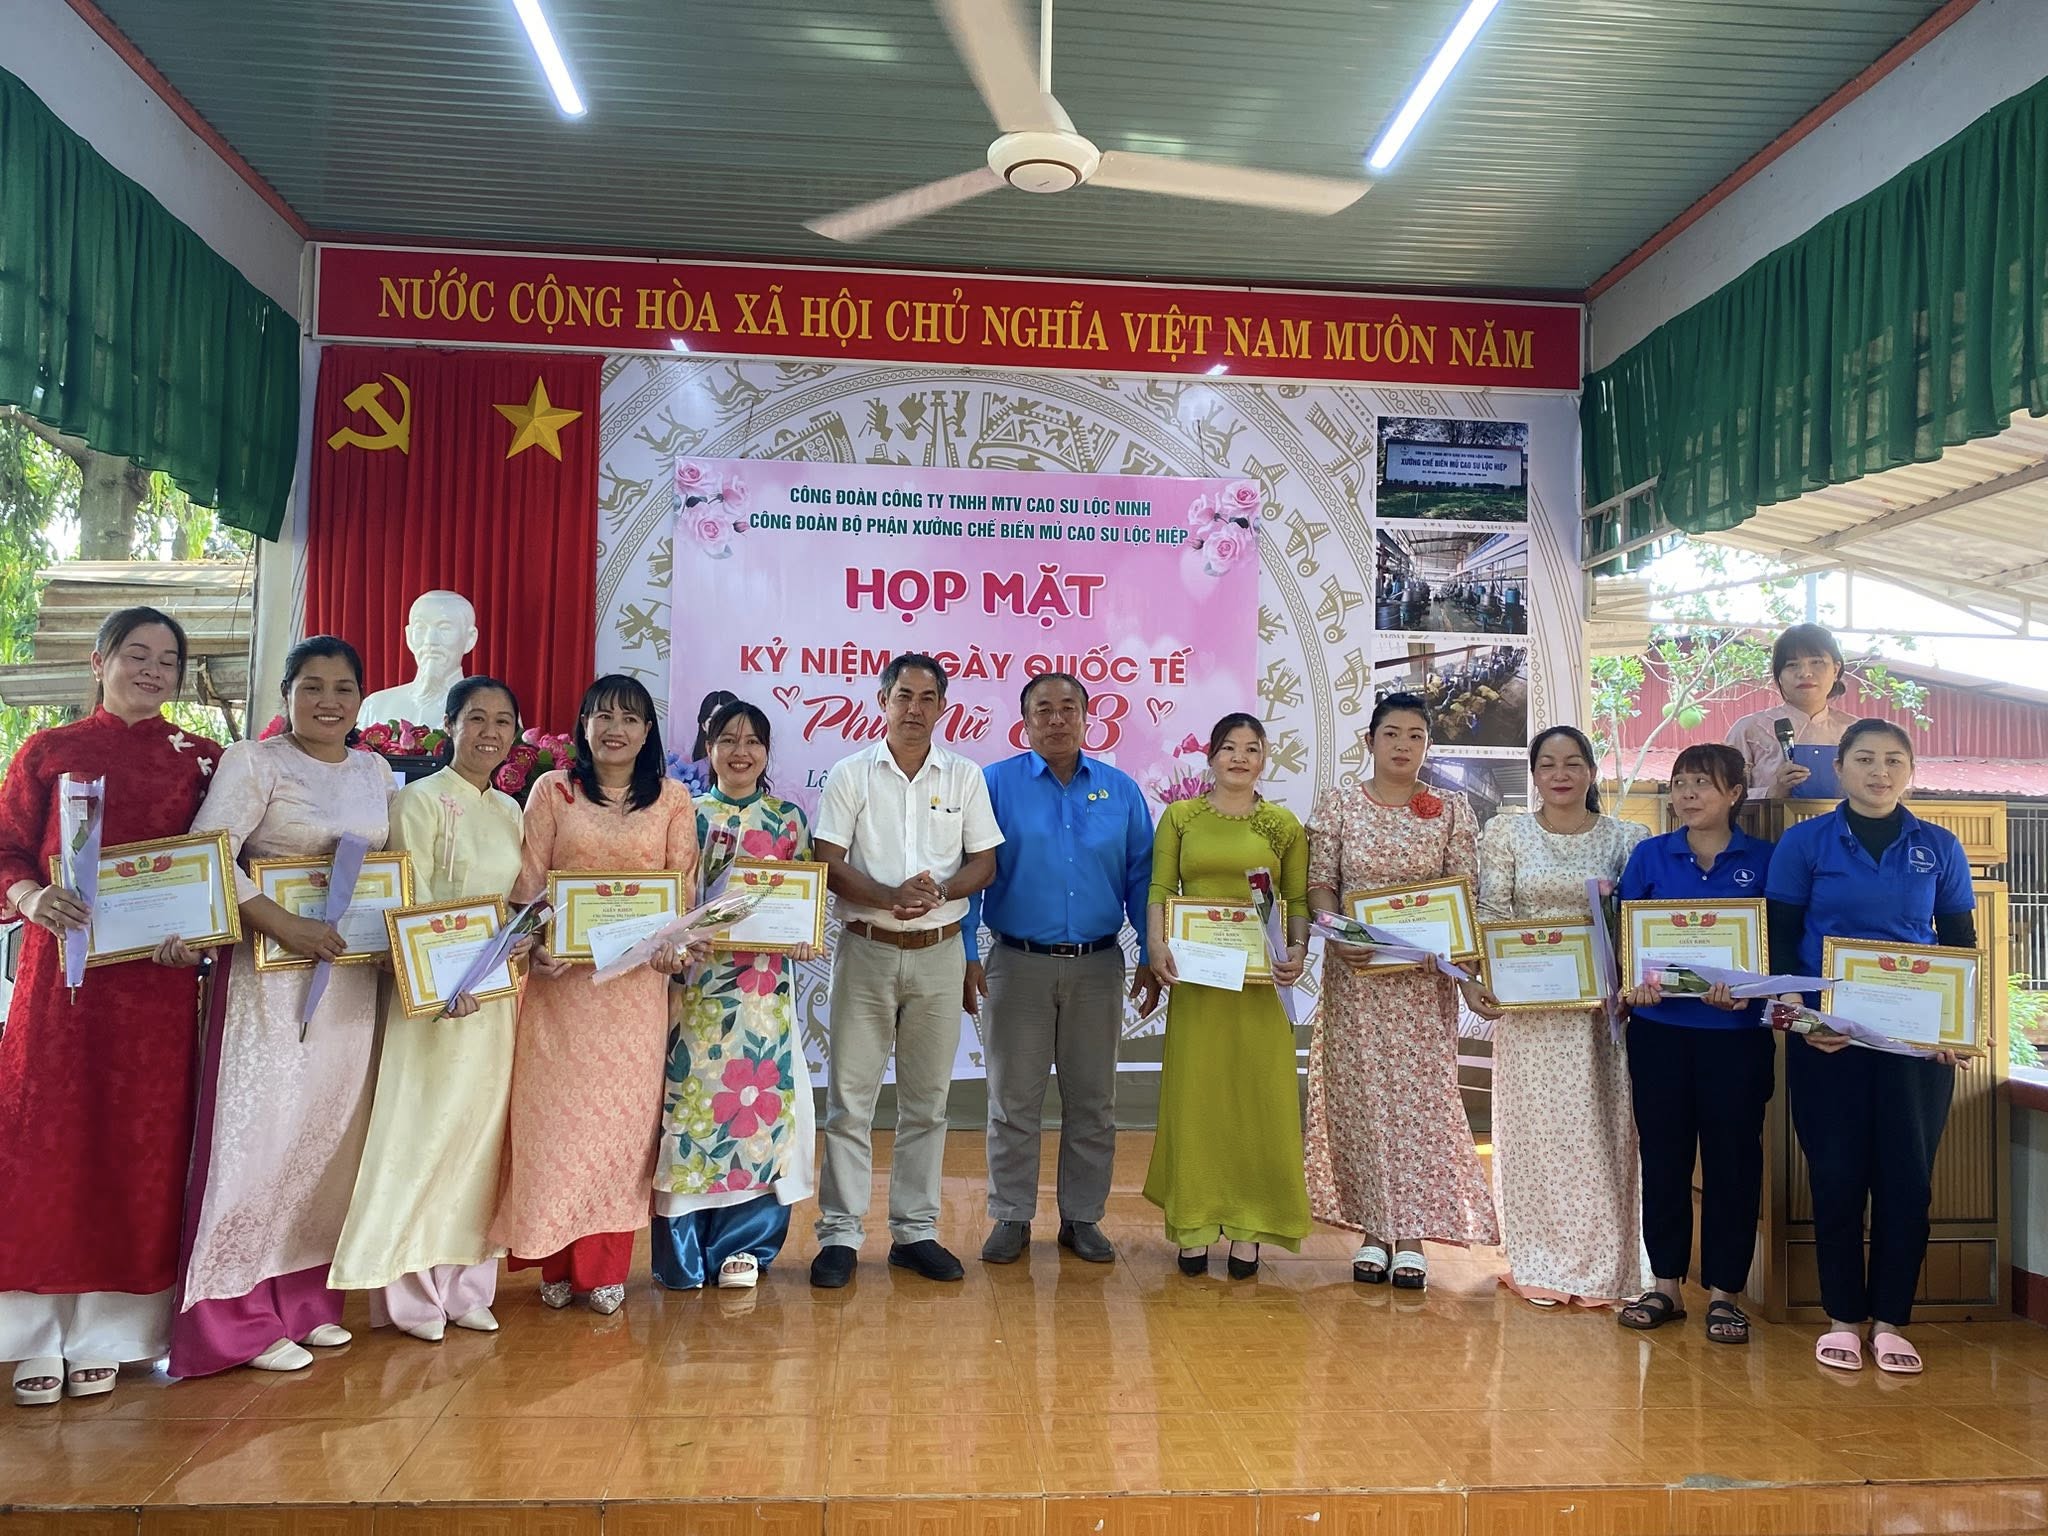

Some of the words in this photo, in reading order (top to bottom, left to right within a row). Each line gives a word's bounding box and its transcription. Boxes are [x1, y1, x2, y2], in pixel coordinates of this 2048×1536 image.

[378, 267, 494, 322] NƯỚC
[509, 273, 623, 334] CỘNG
[635, 280, 721, 332] HÒA
[734, 285, 789, 336] XÃ
[800, 287, 873, 348] HỘI
[885, 287, 970, 344] CHỦ
[982, 300, 1109, 351] NGHĨA
[1120, 304, 1212, 363] VIỆT
[1224, 317, 1313, 359] NAM
[1323, 315, 1437, 365] MUÔN
[1449, 320, 1535, 369] NĂM
[790, 485, 831, 504] CÔNG
[836, 488, 877, 506] ĐOÀN
[882, 489, 923, 507] CÔNG
[927, 493, 944, 509] TY
[949, 494, 987, 511] TNHH
[992, 496, 1022, 512] MTV
[1027, 497, 1055, 513] CAO
[1060, 499, 1079, 514] SU
[1084, 497, 1111, 518] LỘC
[1115, 501, 1151, 516] NINH
[750, 511, 791, 530] CÔNG
[796, 513, 837, 532] ĐOÀN
[842, 515, 862, 536] BỘ
[867, 516, 908, 537] PHẬN
[912, 516, 963, 537] XƯỞNG
[967, 518, 996, 538] CHẾ
[1001, 519, 1035, 540] BIẾN
[1039, 521, 1063, 540] MỦ
[1067, 526, 1096, 541] CAO
[1100, 527, 1119, 542] SU
[1124, 525, 1151, 546] LỘC
[1156, 528, 1189, 547] HIỆP
[845, 567, 967, 623] HỌP
[982, 564, 1104, 627] MẶT
[740, 637, 788, 673] KỶ
[801, 641, 891, 683] NIỆM
[906, 644, 1013, 680] GÀY
[1024, 644, 1139, 683] QUỐC
[1149, 646, 1194, 684] TẾ
